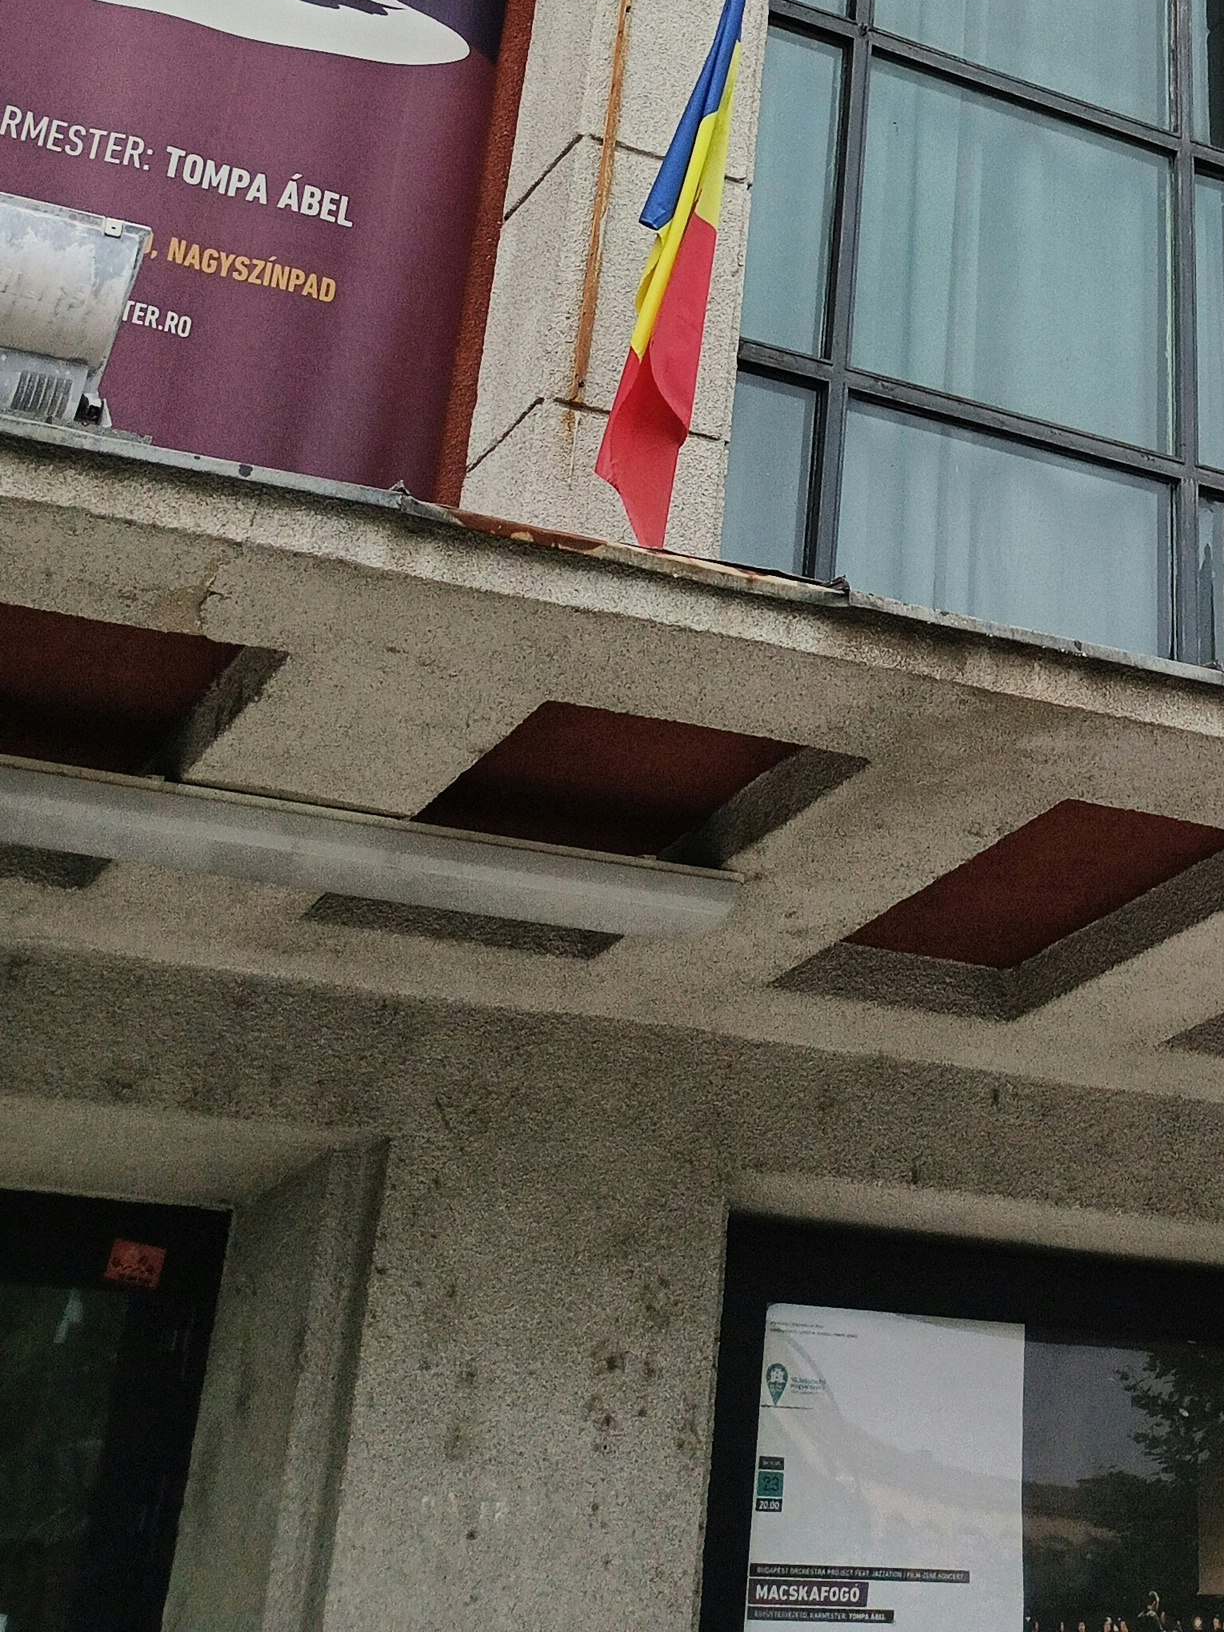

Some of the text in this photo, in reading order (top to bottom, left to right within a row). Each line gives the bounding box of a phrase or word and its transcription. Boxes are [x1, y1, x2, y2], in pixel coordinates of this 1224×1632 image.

[0, 104, 353, 228] RMESTER: TOMPA ÁBEL
[167, 236, 337, 303] NAGYSZÍNPAD
[755, 1583, 860, 1602] MACSKAFOGÓ
